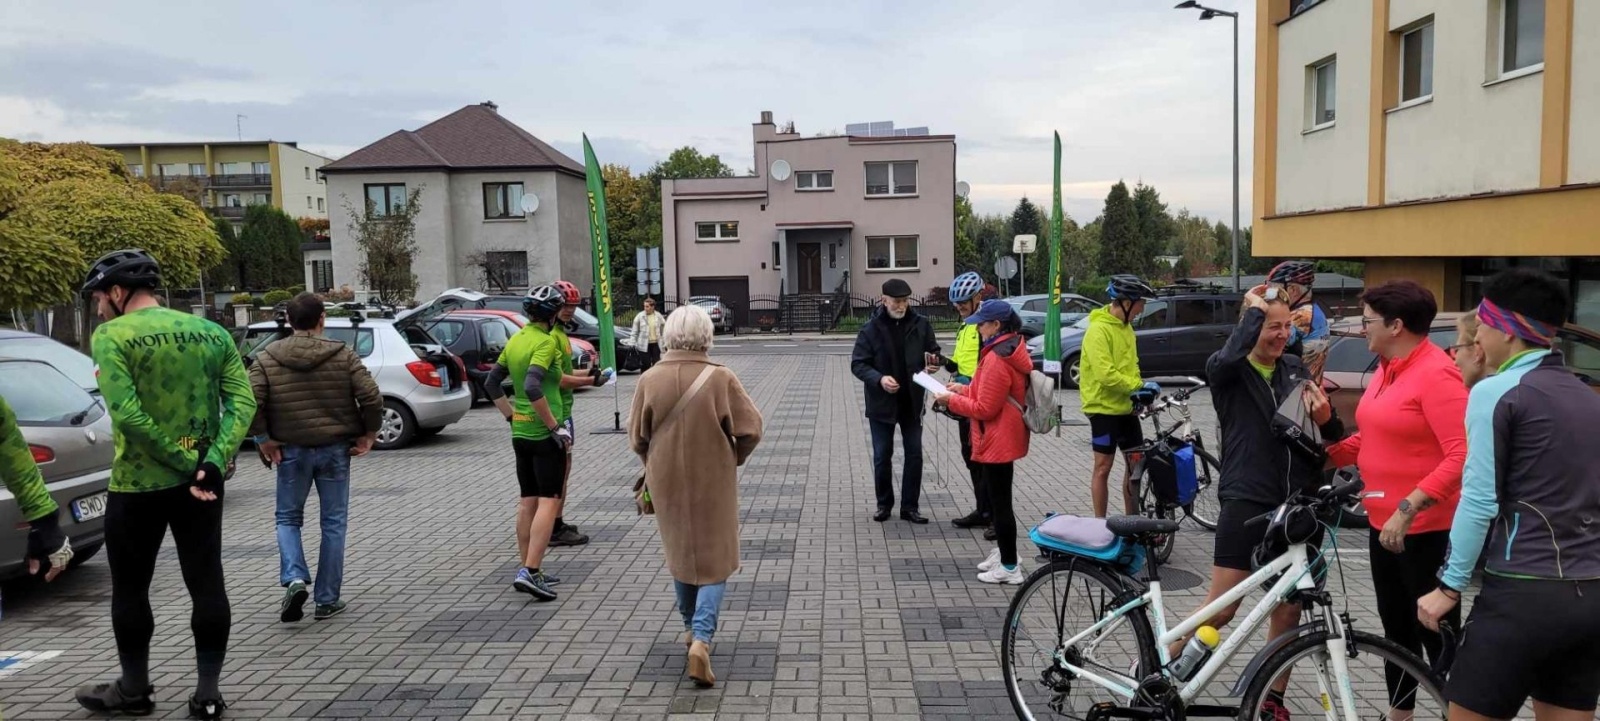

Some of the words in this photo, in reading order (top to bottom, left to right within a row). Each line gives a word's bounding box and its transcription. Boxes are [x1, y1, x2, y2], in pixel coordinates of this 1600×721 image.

[126, 332, 170, 350] WOJT
[173, 331, 224, 347] HANYS
[79, 496, 103, 516] SWD
